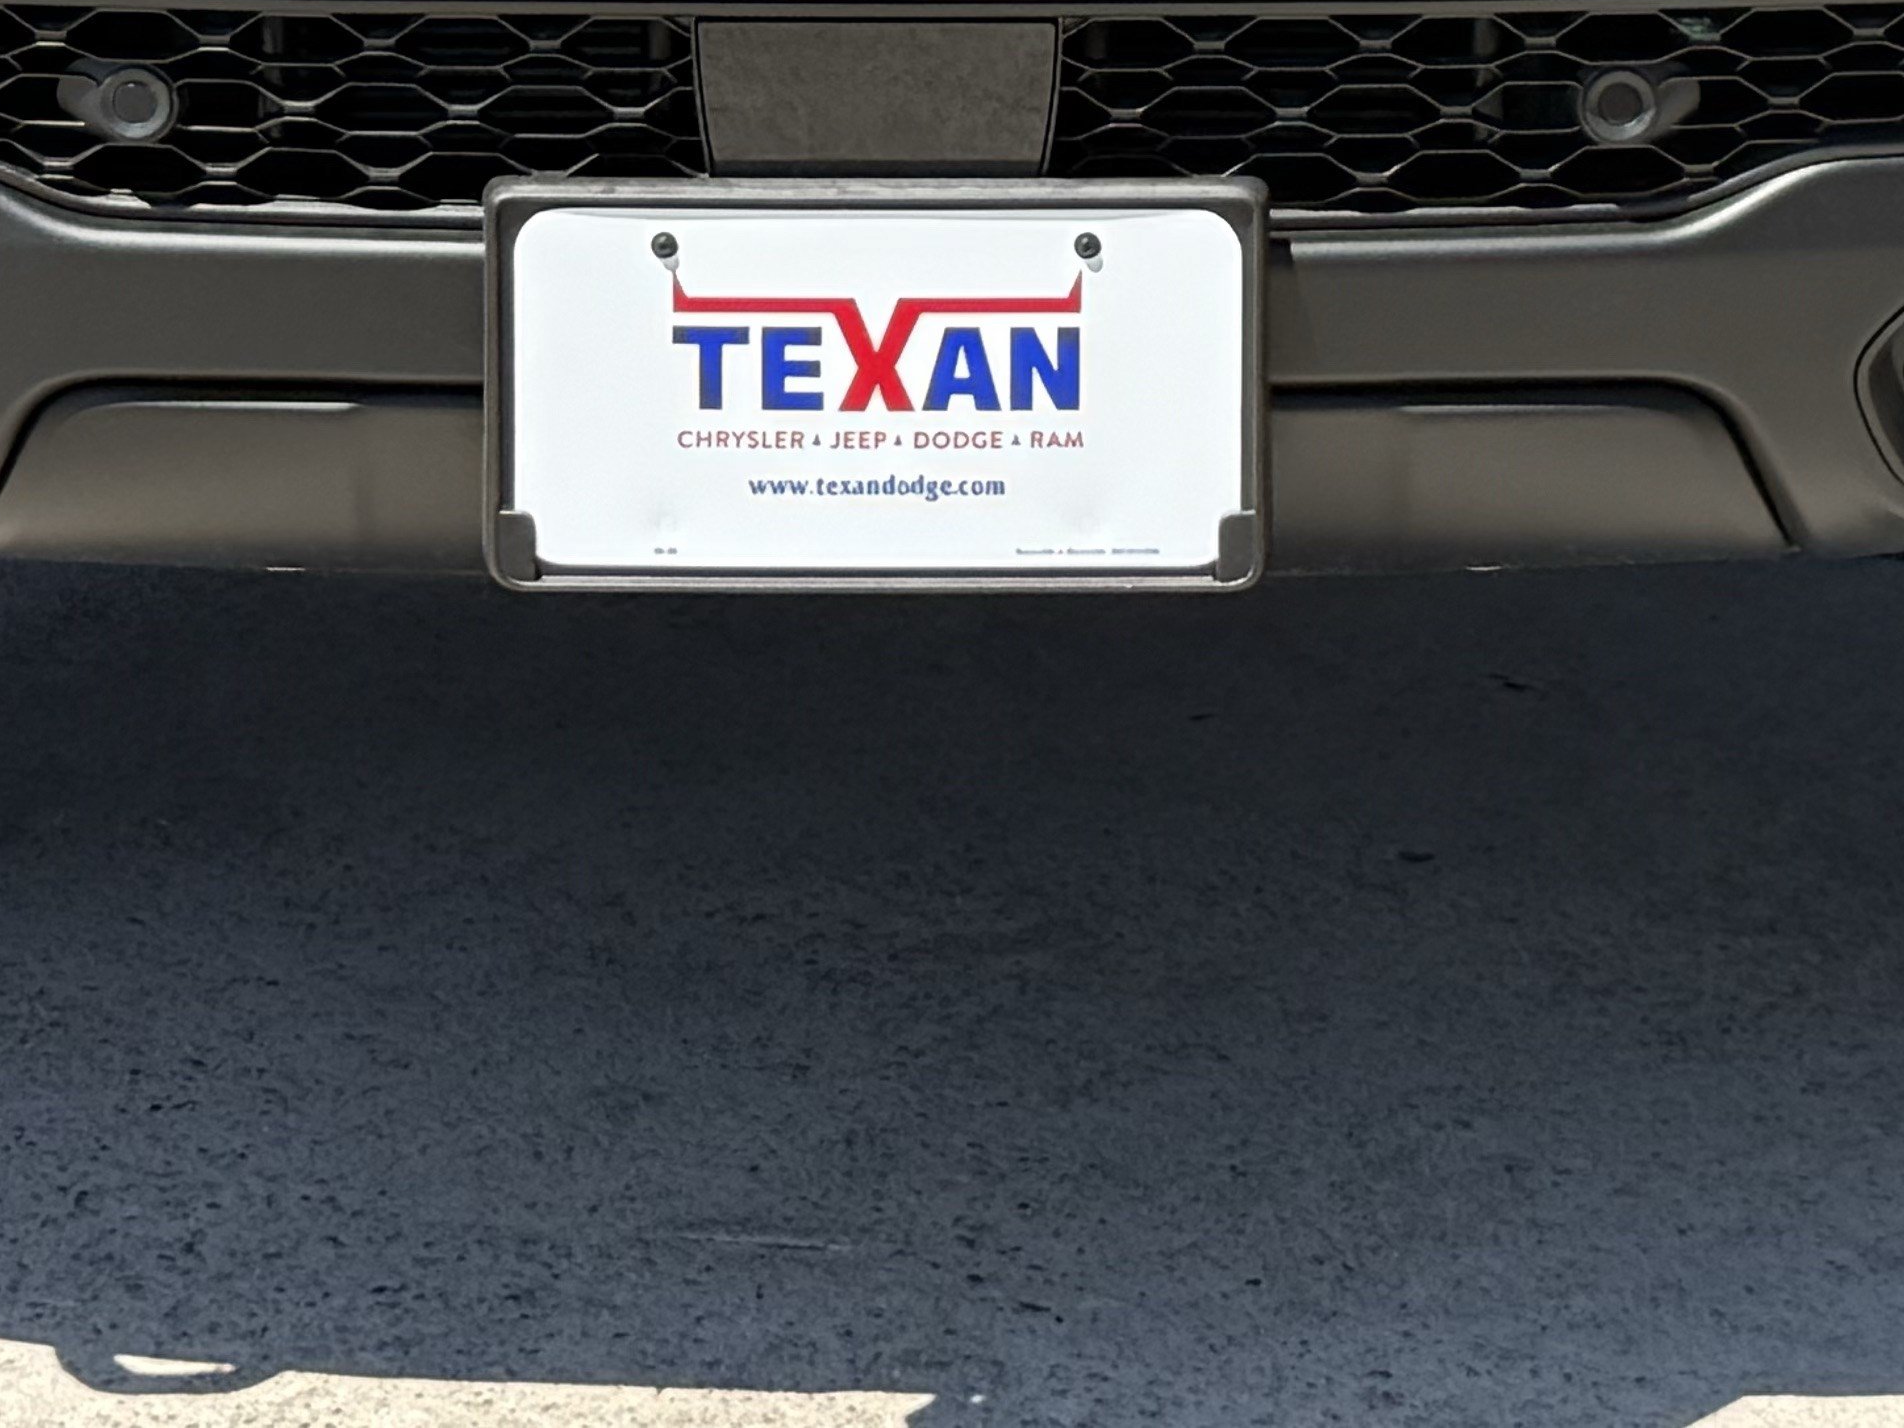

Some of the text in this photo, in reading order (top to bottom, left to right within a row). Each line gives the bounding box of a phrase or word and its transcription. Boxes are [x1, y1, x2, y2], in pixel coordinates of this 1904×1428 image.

[672, 298, 1081, 412] TEXAN
[676, 430, 1084, 450] CHRYSLER JEEP DODGE RAM
[748, 473, 1006, 502] www.texandodge.com
